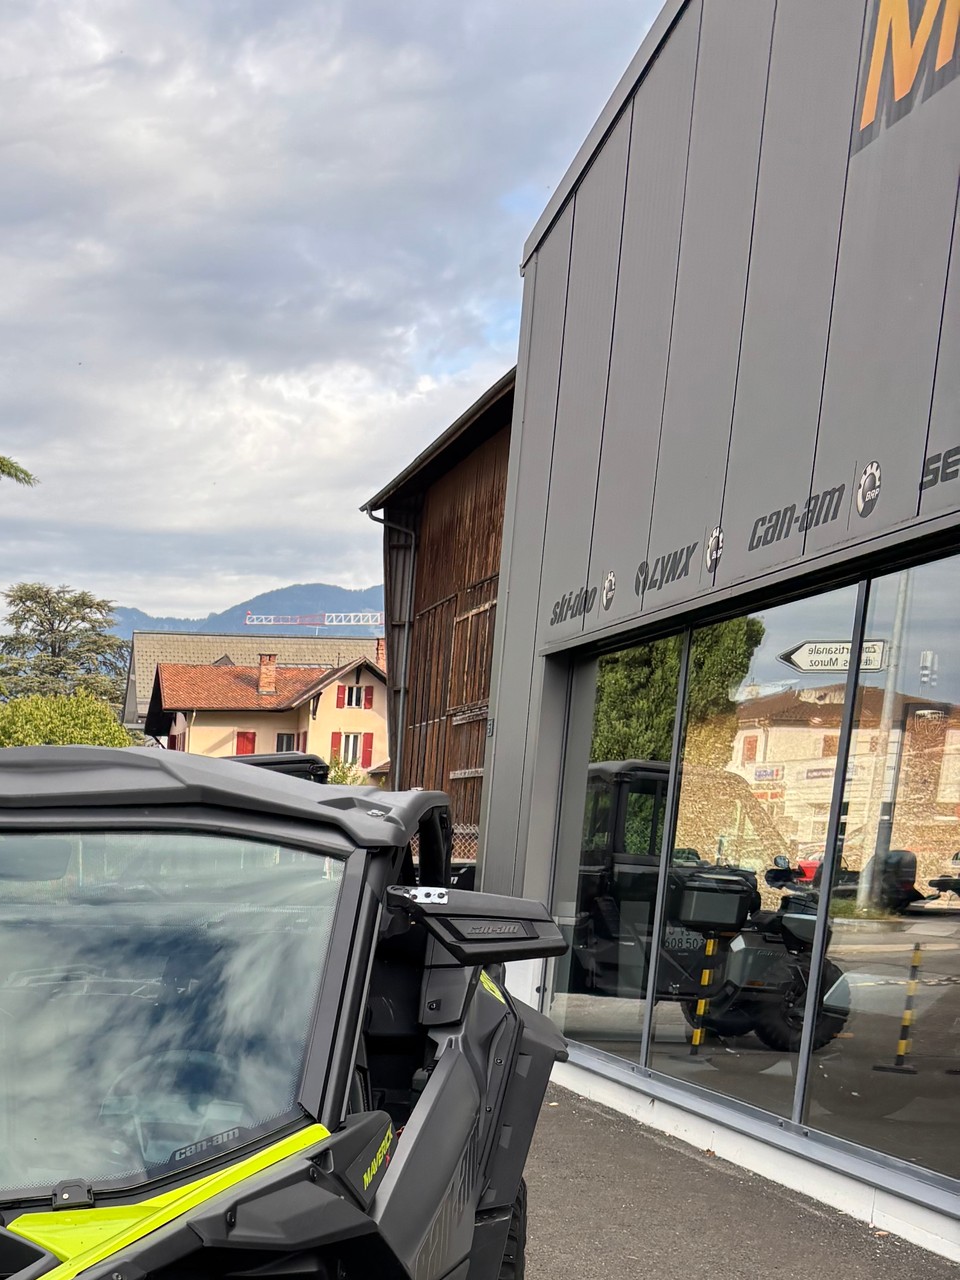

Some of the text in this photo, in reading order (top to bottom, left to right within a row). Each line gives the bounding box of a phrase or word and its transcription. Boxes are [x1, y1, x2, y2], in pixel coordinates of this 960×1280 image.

[860, 0, 960, 131] M
[747, 483, 846, 552] can-am
[865, 488, 880, 502] BRP
[647, 541, 699, 591] LYNX
[550, 586, 597, 626] ski-doo
[174, 1127, 240, 1161] can-am
